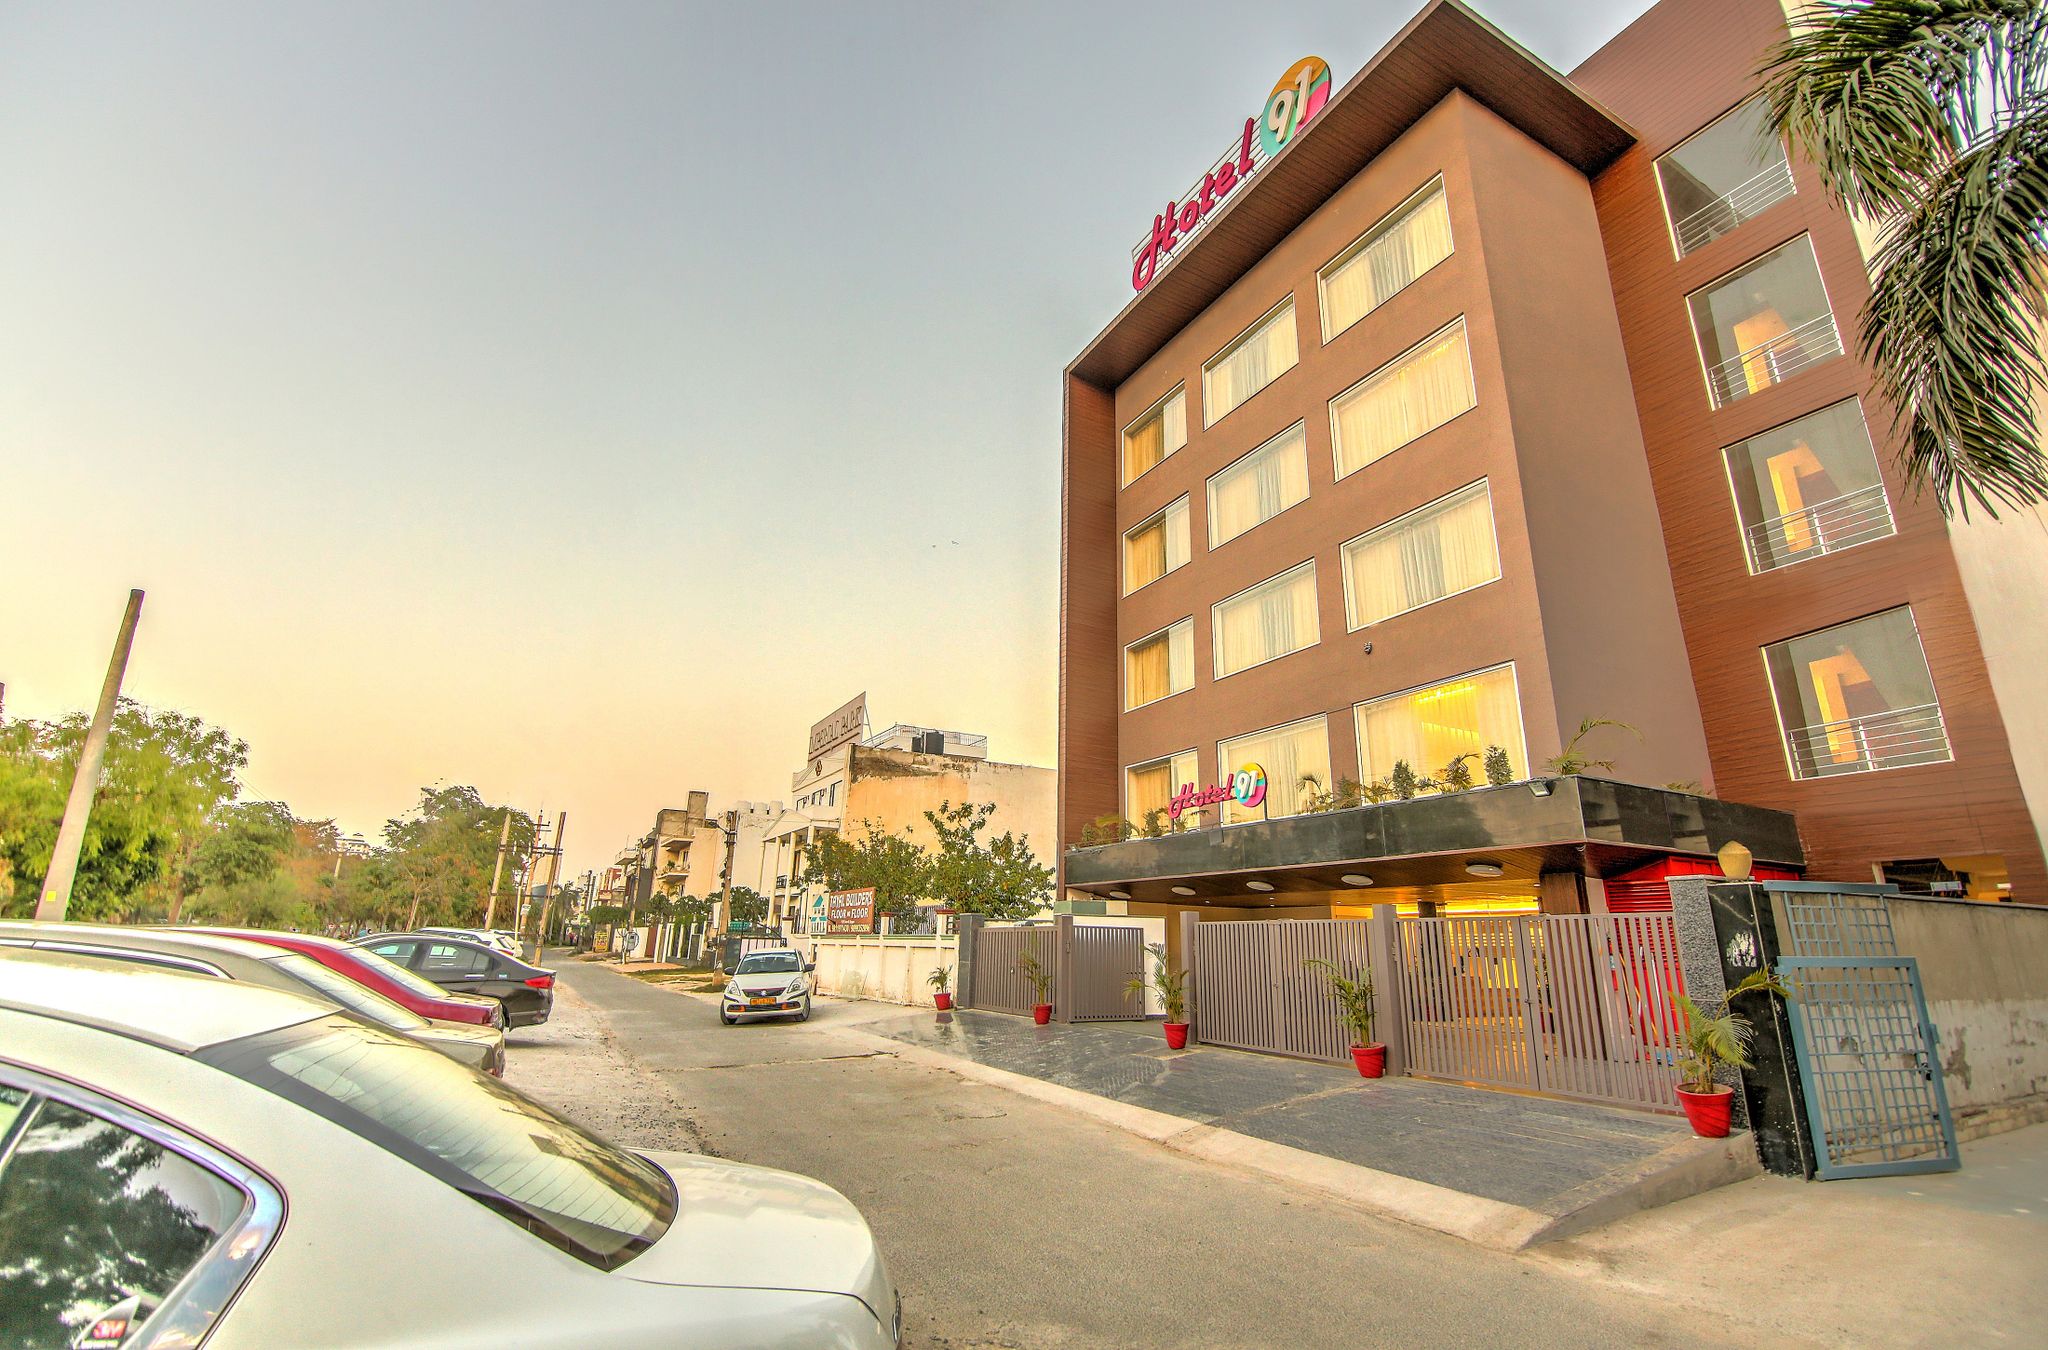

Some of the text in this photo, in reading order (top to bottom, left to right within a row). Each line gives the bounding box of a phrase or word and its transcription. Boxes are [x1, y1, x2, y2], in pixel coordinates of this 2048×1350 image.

[1132, 65, 1313, 291] Hotel 91
[1168, 770, 1258, 819] Hotel 91
[847, 892, 872, 907] BUILDERS
[852, 908, 868, 918] FLOOR
